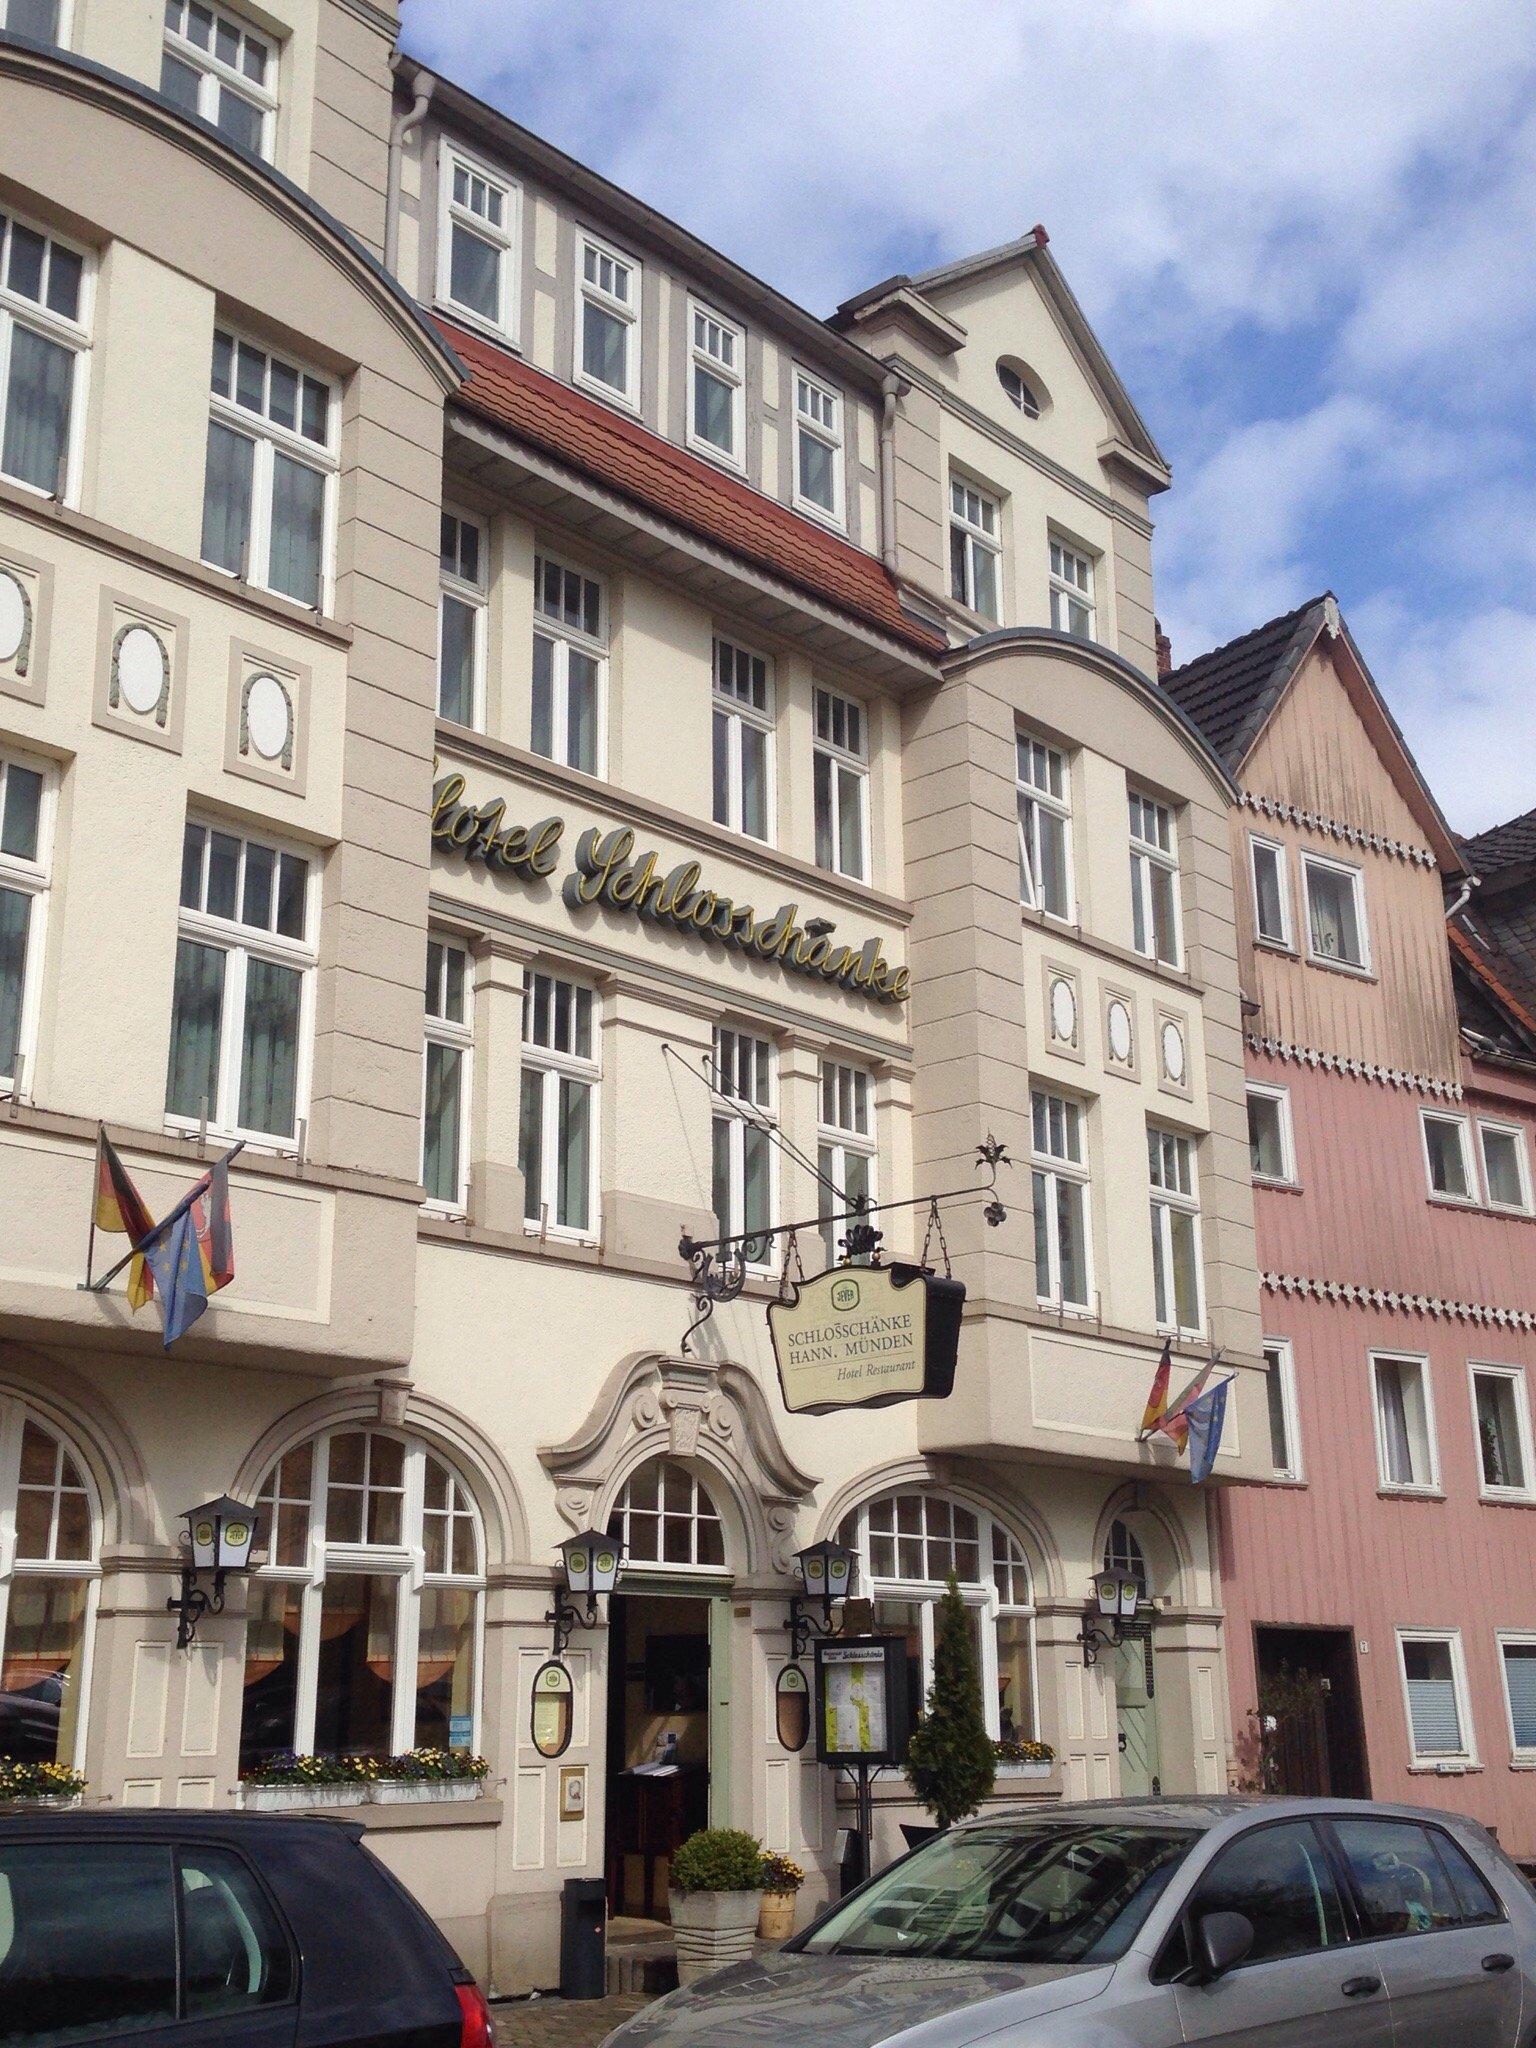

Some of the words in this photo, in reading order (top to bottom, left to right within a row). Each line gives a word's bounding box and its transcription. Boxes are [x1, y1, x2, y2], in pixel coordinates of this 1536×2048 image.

[789, 1345, 838, 1364] HANN.
[844, 1332, 913, 1356] MÜNDEN
[837, 1364, 863, 1381] Hotel
[866, 1360, 916, 1377] Restaurant
